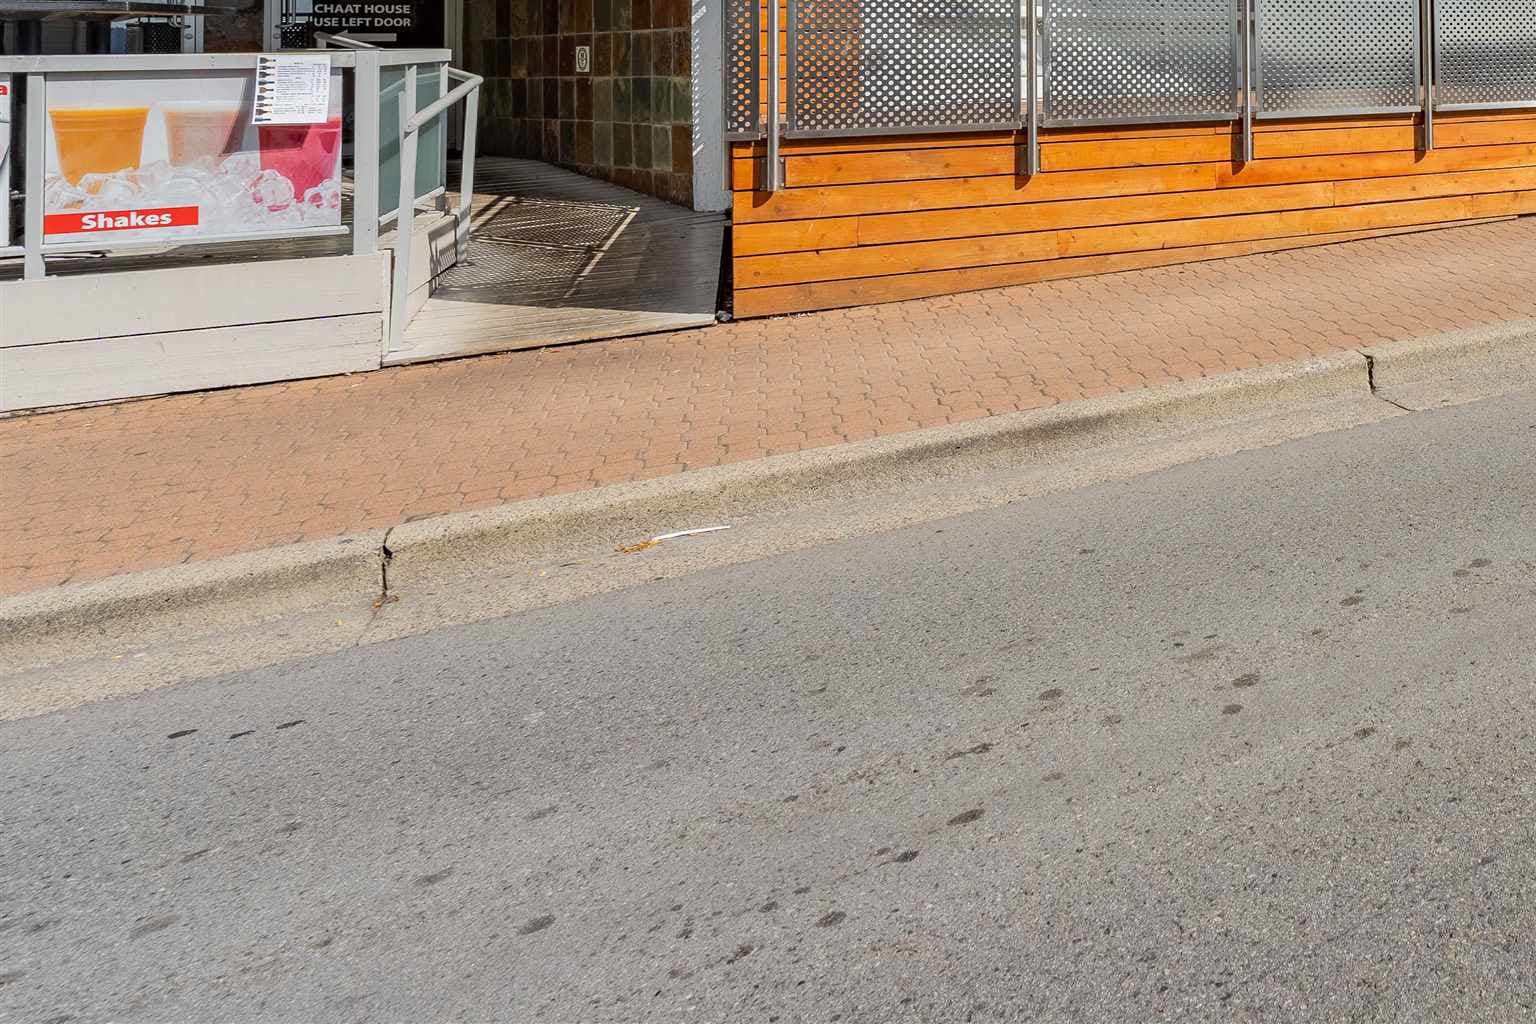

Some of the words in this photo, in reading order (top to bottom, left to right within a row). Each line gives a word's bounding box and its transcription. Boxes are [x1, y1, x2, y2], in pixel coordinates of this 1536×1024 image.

[314, 3, 362, 14] CHAAT
[364, 4, 412, 14] HOUSE
[314, 17, 340, 27] USE
[342, 17, 372, 27] LEFT
[374, 17, 412, 27] DOOR
[80, 212, 173, 230] Shakes
